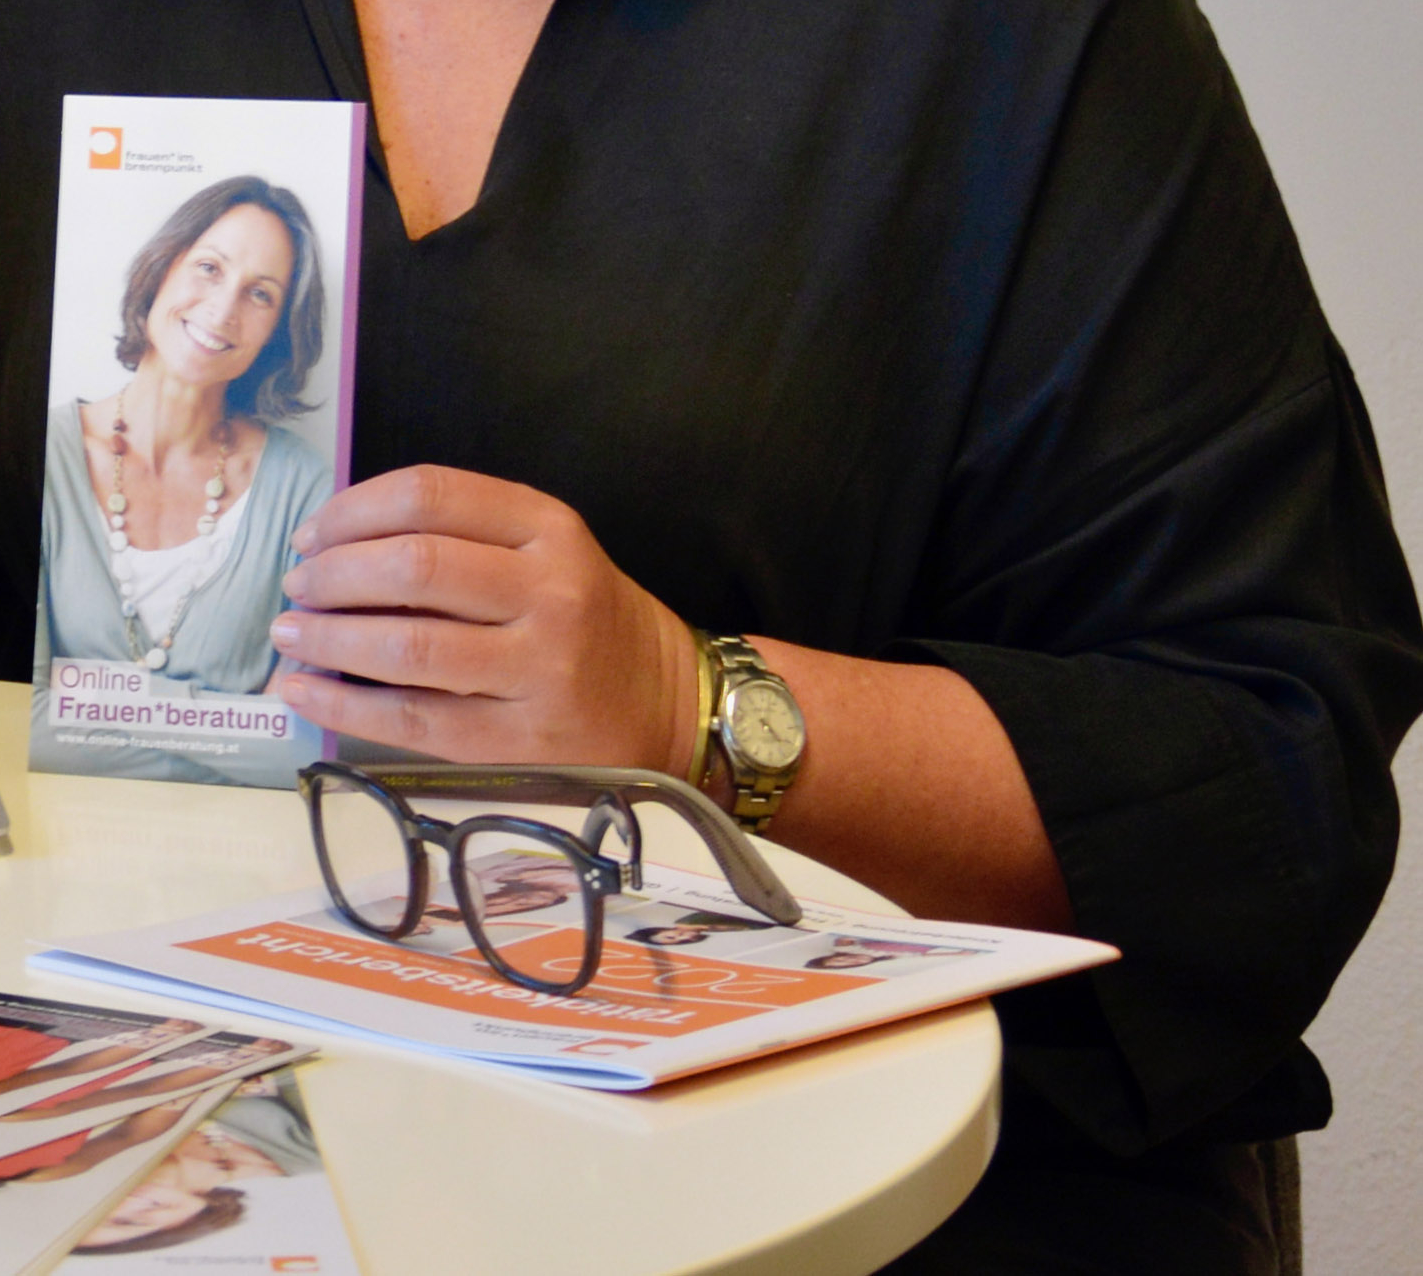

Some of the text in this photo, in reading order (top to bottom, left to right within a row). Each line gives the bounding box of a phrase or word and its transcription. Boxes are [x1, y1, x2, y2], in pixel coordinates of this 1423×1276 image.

[59, 664, 142, 692] Online
[236, 931, 698, 1025] Tätigkeitsbericht
[541, 947, 805, 994] 2022
